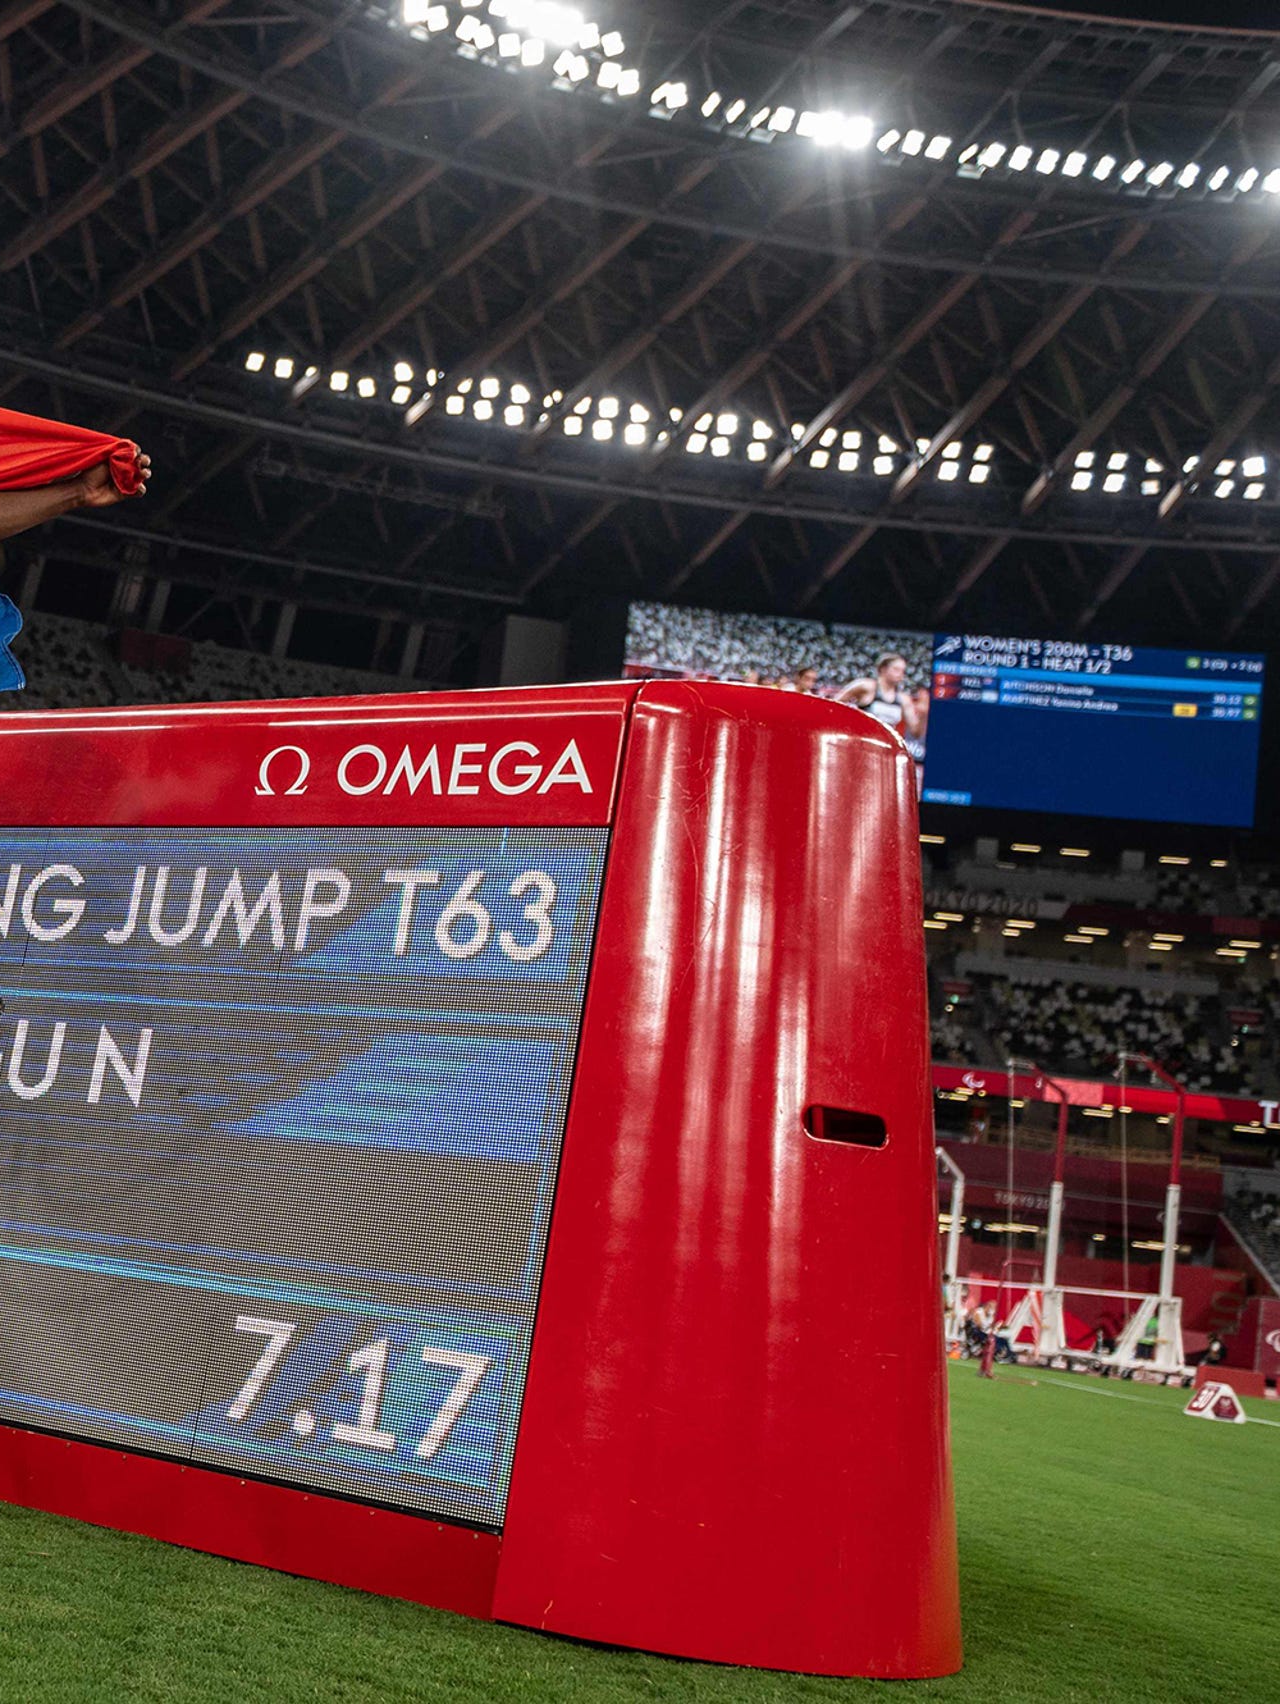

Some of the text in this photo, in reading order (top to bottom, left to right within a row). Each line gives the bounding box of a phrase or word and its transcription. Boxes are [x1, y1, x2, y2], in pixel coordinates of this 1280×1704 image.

[962, 650, 1017, 667] ROUND
[1042, 657, 1082, 673] HEAT
[963, 634, 1041, 655] WOMEN'S
[337, 738, 593, 795] OMEGA
[104, 865, 353, 953] JUMP
[384, 870, 558, 962] T63
[87, 1023, 153, 1109] N
[226, 1315, 493, 1459] 7.17
